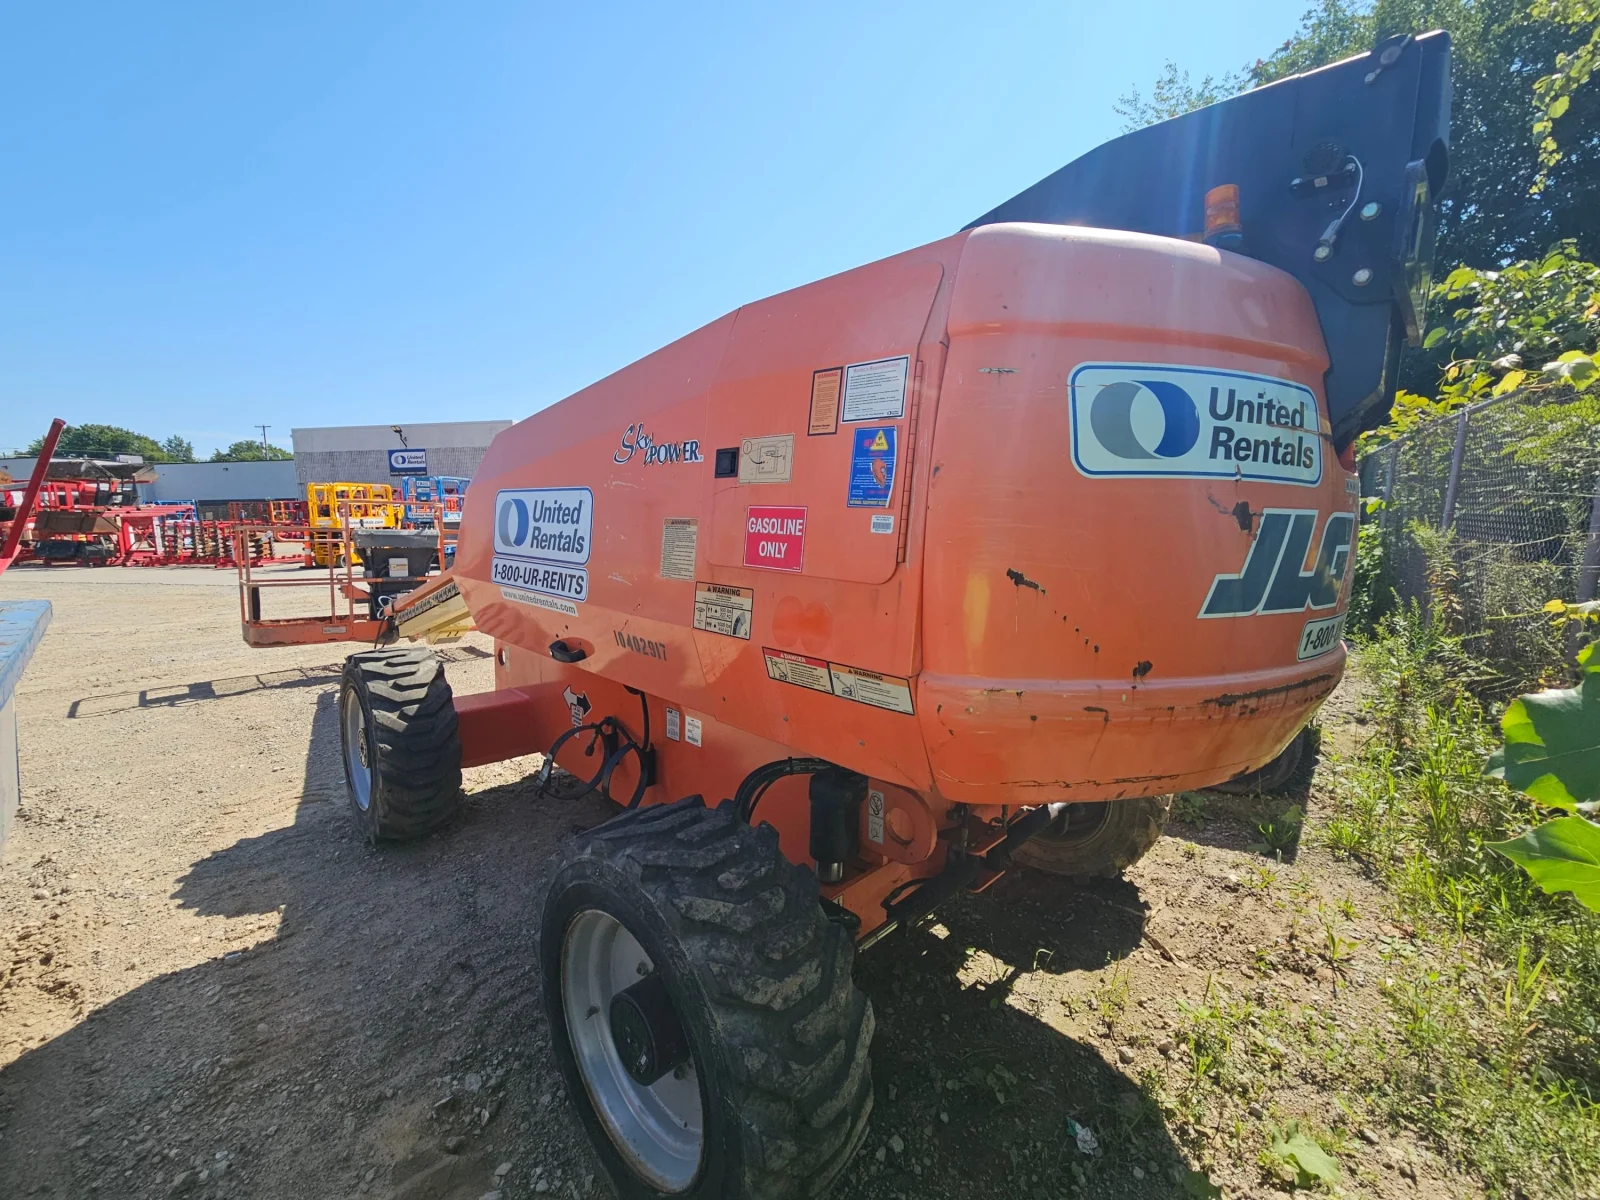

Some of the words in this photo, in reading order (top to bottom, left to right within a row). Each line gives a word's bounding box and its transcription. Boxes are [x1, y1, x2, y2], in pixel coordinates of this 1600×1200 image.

[817, 371, 838, 379] WARNING
[1208, 386, 1305, 429] United
[1209, 426, 1314, 469] Rentals
[532, 499, 582, 525] United
[748, 517, 803, 536] GASOLINE
[530, 526, 585, 554] Rentals
[759, 541, 788, 558] ONLY
[1197, 508, 1355, 619] JLG
[493, 562, 585, 595] 1-800-UR-RENTS
[502, 590, 576, 614] www.unitedrentals.com
[712, 586, 741, 597] WARNING
[613, 629, 667, 661] 10402917
[784, 653, 807, 663] DANGER
[853, 669, 883, 681] WARNING
